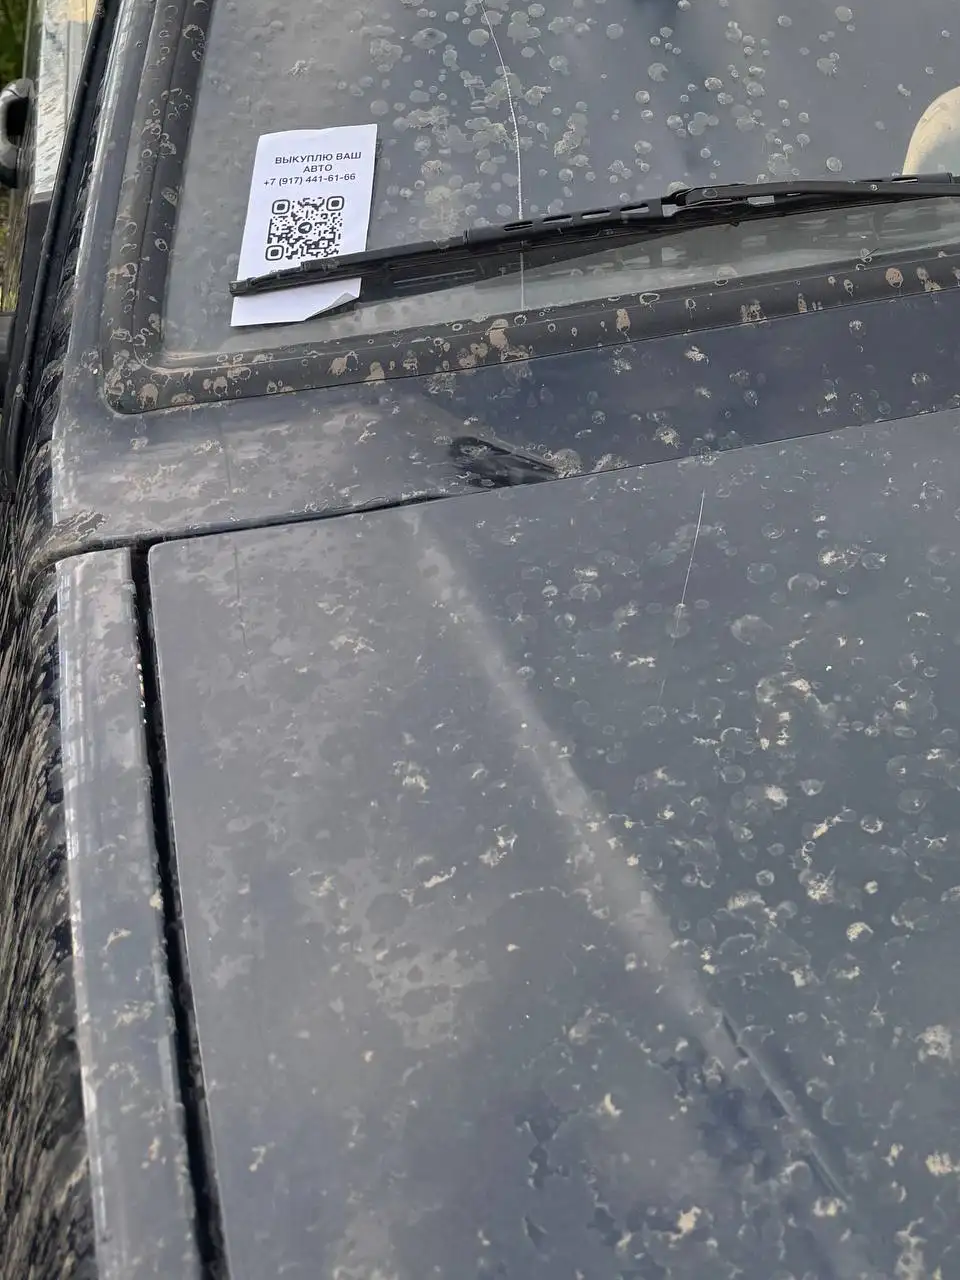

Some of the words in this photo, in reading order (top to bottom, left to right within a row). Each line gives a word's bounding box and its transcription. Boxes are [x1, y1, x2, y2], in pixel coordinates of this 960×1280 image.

[275, 153, 333, 164] ВЫКУПЛЮ
[336, 151, 361, 161] ВАШ
[303, 164, 333, 173] АВТО
[264, 178, 276, 186] +7
[279, 176, 303, 186] (917)
[305, 173, 356, 183] 441-61-66
